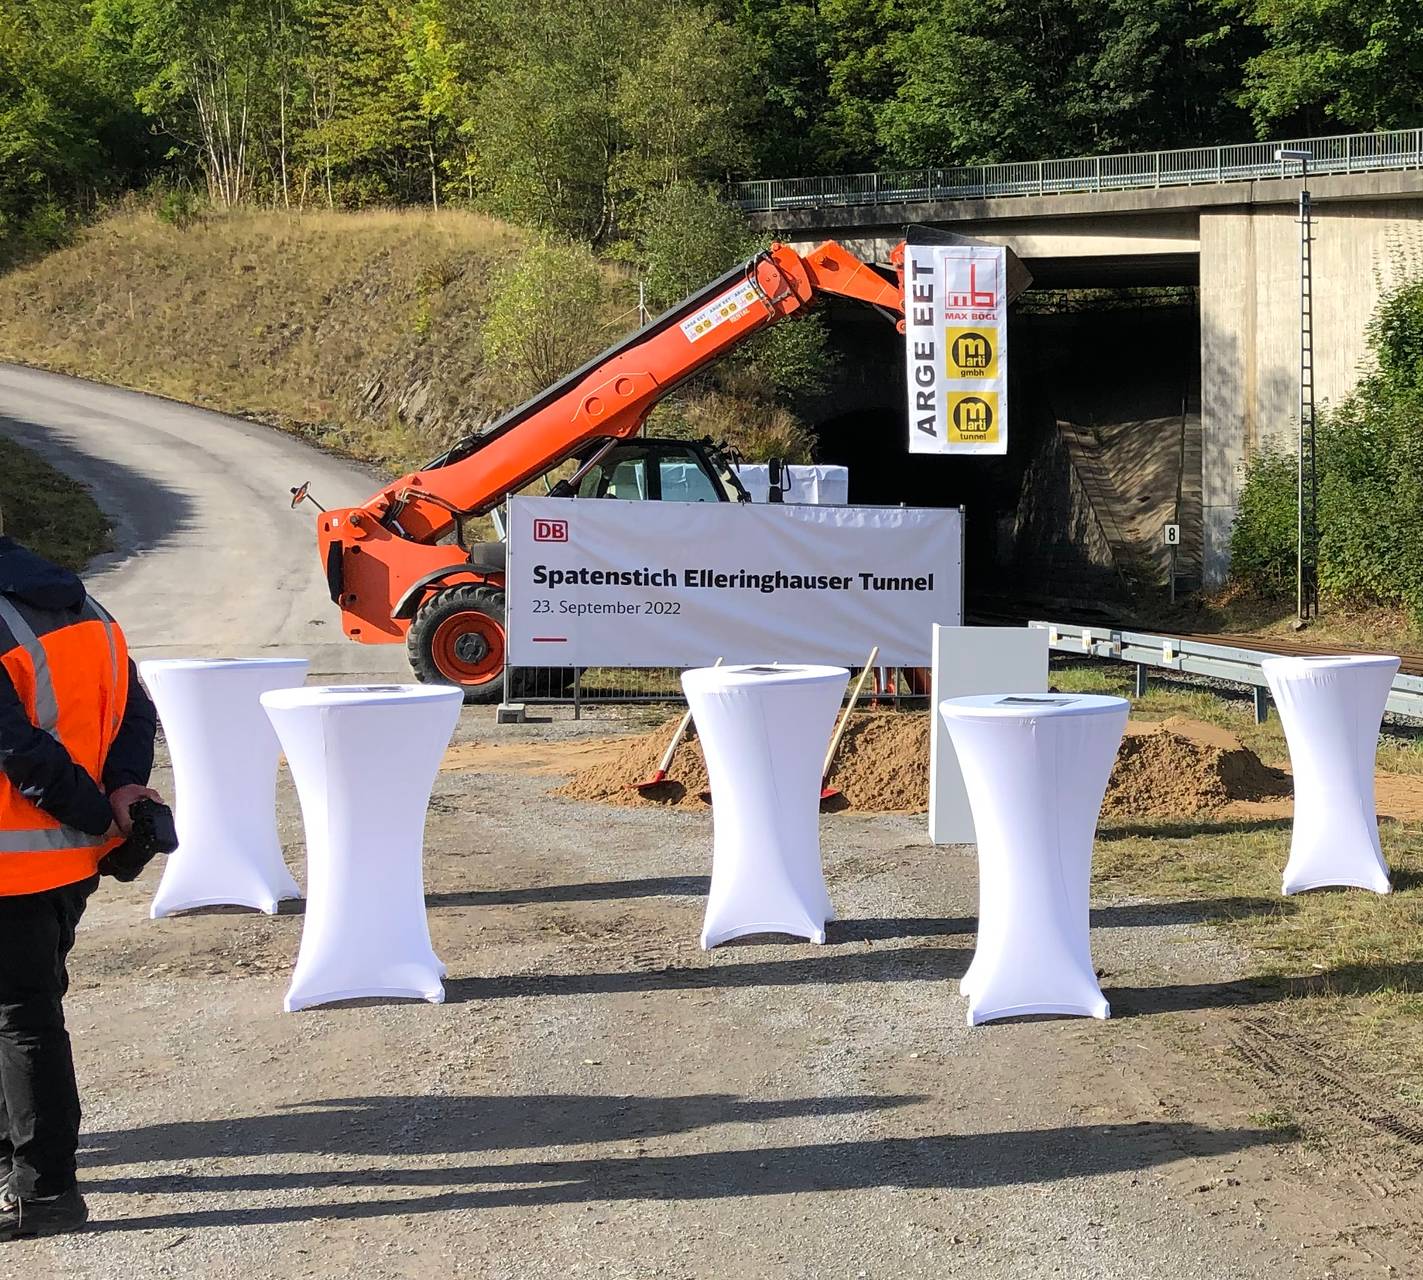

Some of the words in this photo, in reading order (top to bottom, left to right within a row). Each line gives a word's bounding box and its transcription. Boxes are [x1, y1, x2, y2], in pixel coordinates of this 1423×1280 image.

[912, 259, 935, 326] EET
[944, 312, 968, 320] MAX
[960, 368, 985, 377] gmbh
[914, 341, 937, 437] ARGE
[537, 522, 565, 539] DB
[1168, 527, 1176, 542] 8
[532, 565, 678, 589] Spatenstich
[684, 569, 853, 594] Elleringhauser
[858, 572, 935, 591] Tunnel
[532, 599, 554, 614] 23.
[559, 600, 641, 617] September
[644, 601, 681, 615] 2022
